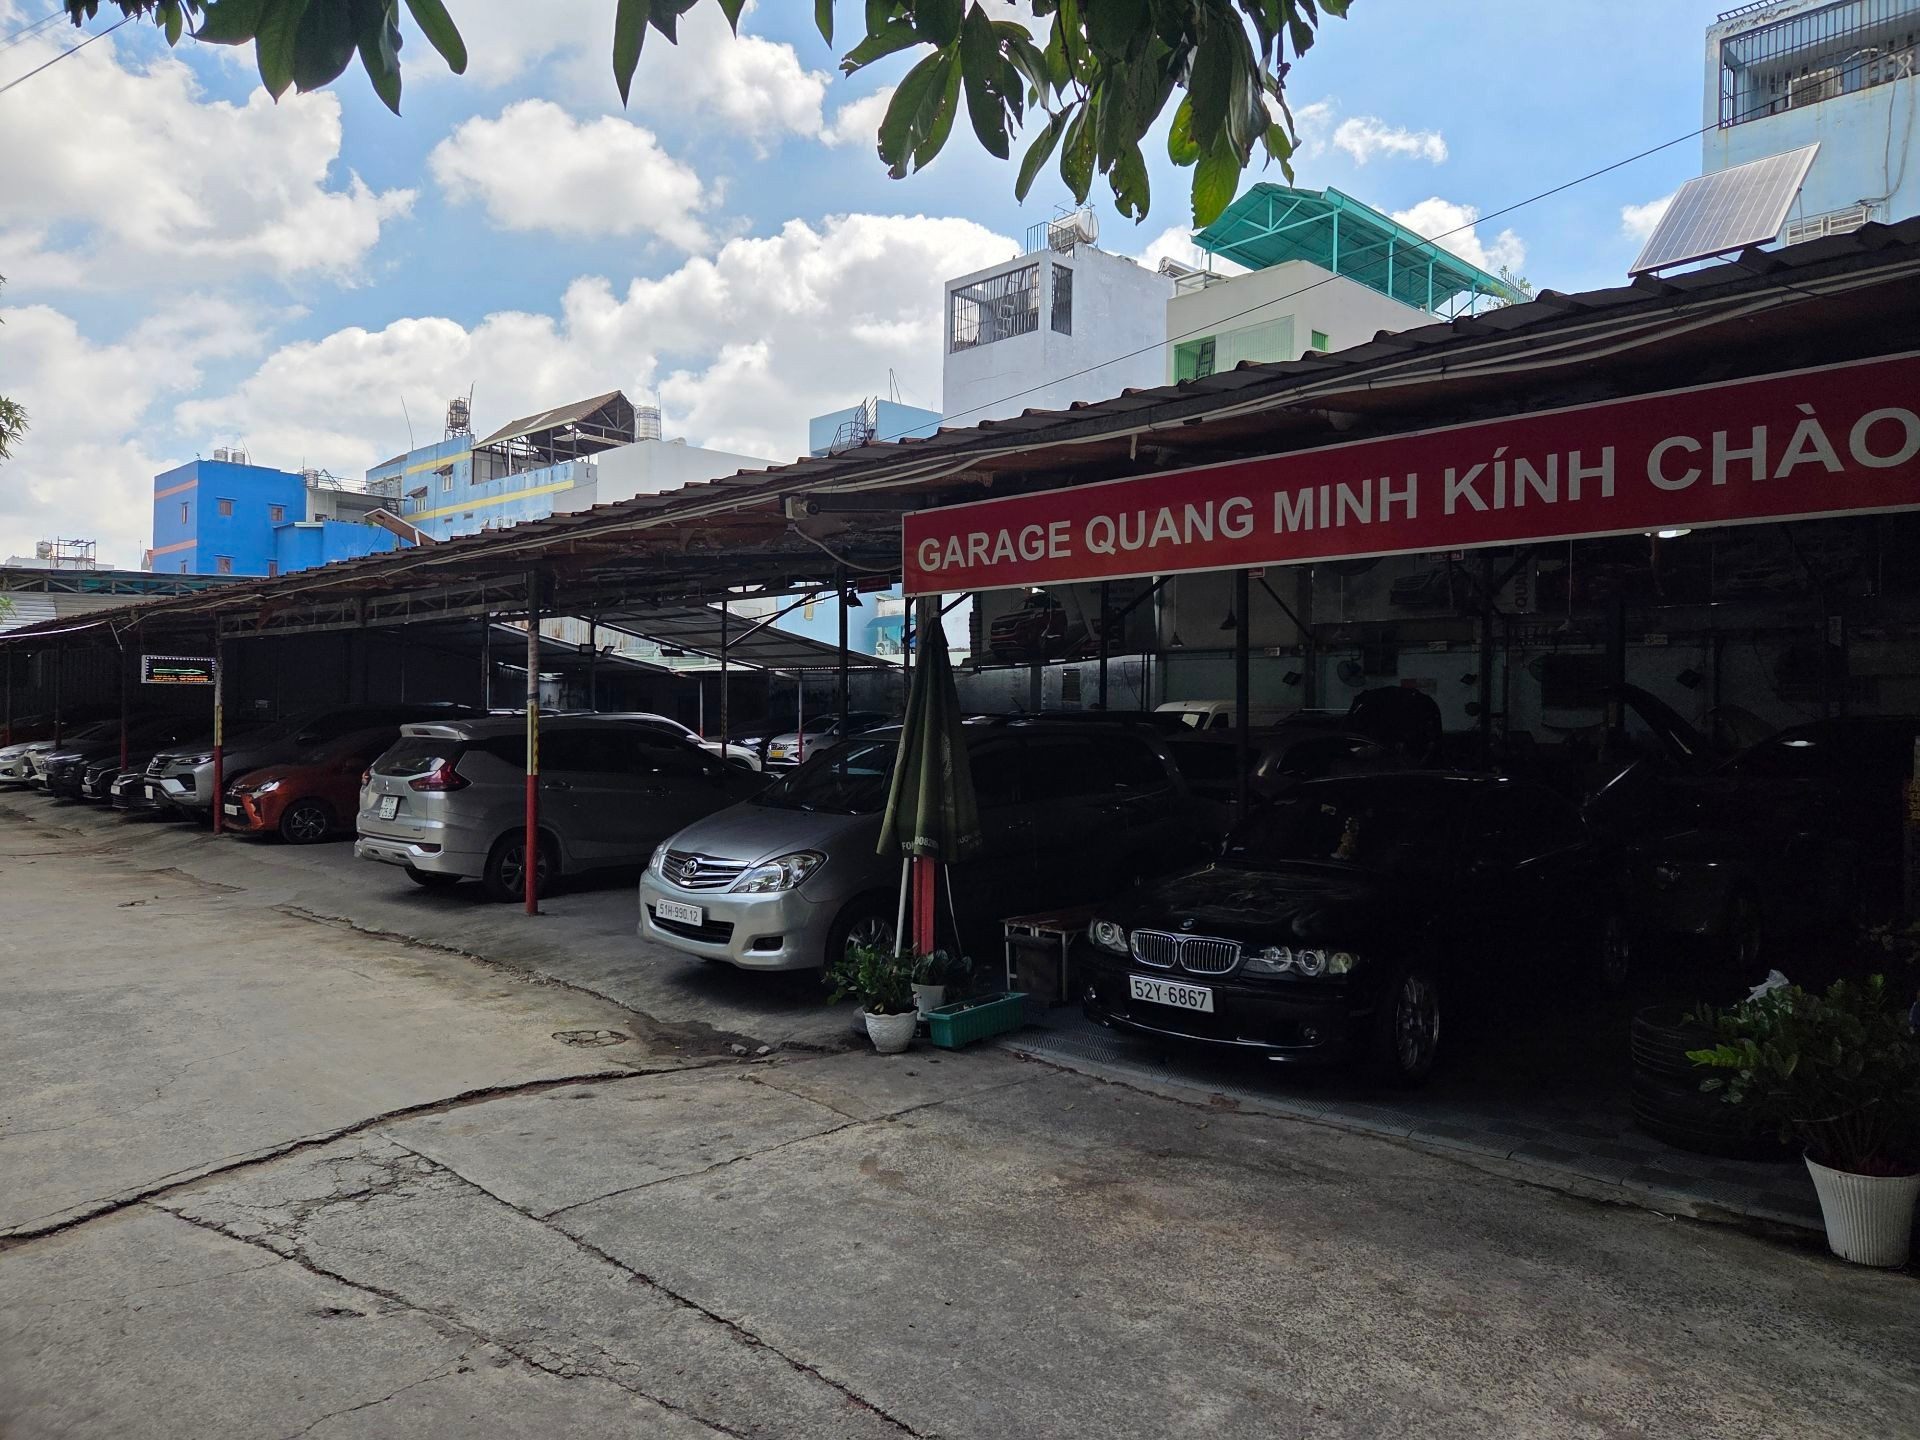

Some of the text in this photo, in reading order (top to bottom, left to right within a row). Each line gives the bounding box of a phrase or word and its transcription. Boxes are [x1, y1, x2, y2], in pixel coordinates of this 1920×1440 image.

[919, 403, 1920, 572] GARAGE QUANG MINH KÍNH CHÀO
[659, 904, 698, 922] 51H-990.12
[1133, 980, 1207, 1009] 52Y-6867
